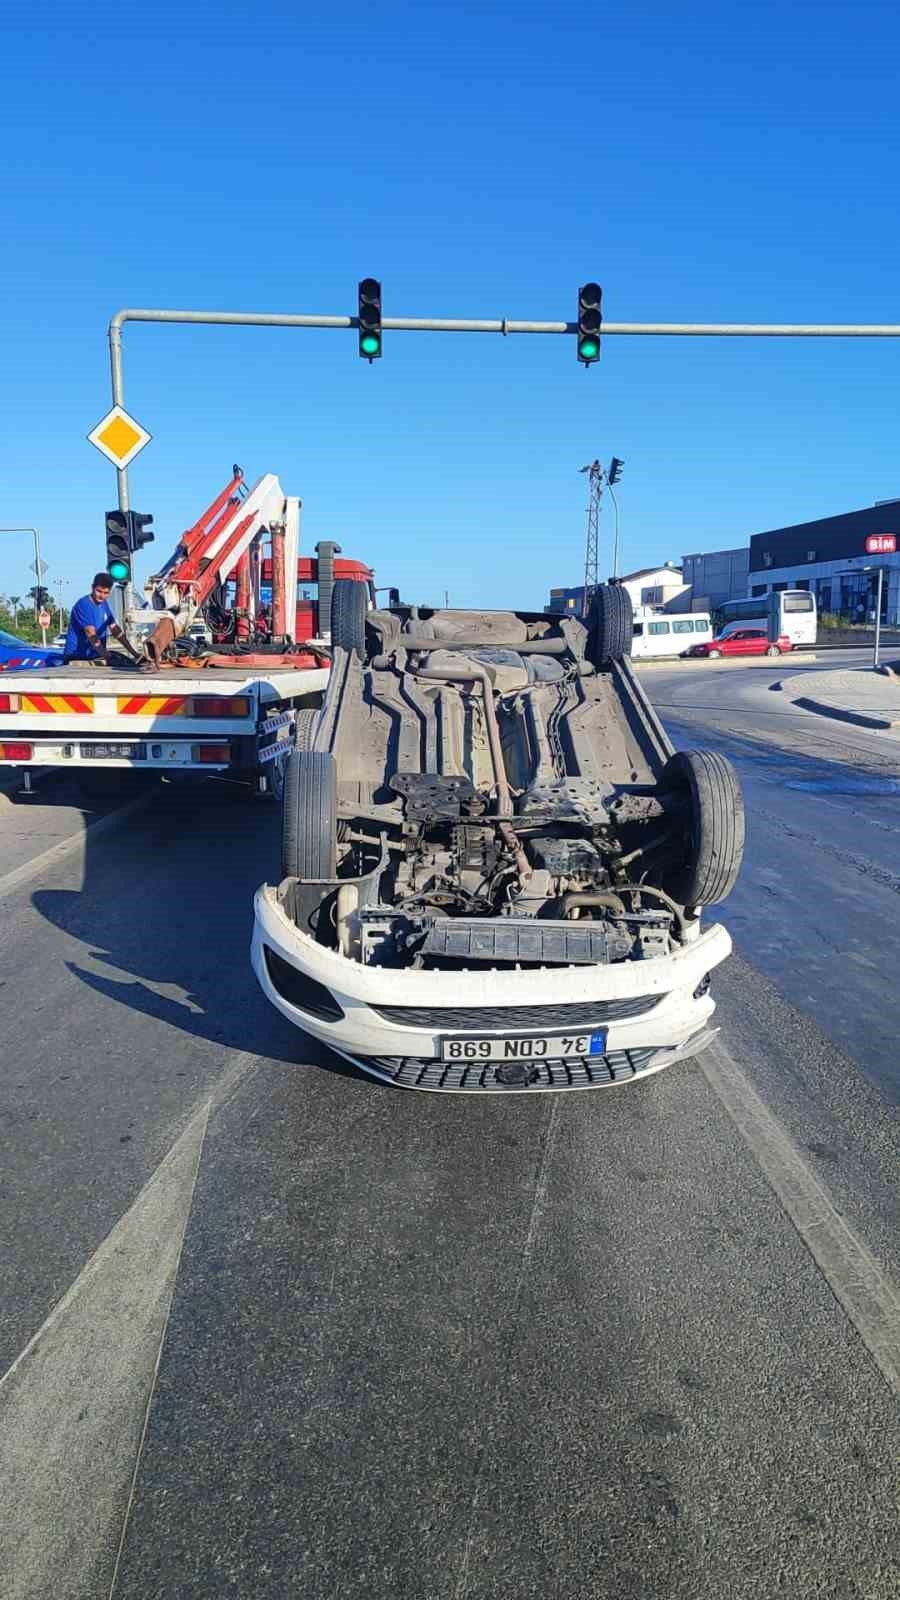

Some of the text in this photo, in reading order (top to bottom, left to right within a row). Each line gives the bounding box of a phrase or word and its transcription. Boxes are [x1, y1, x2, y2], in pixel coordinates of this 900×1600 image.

[449, 1036, 588, 1058] 34 CDN 698
